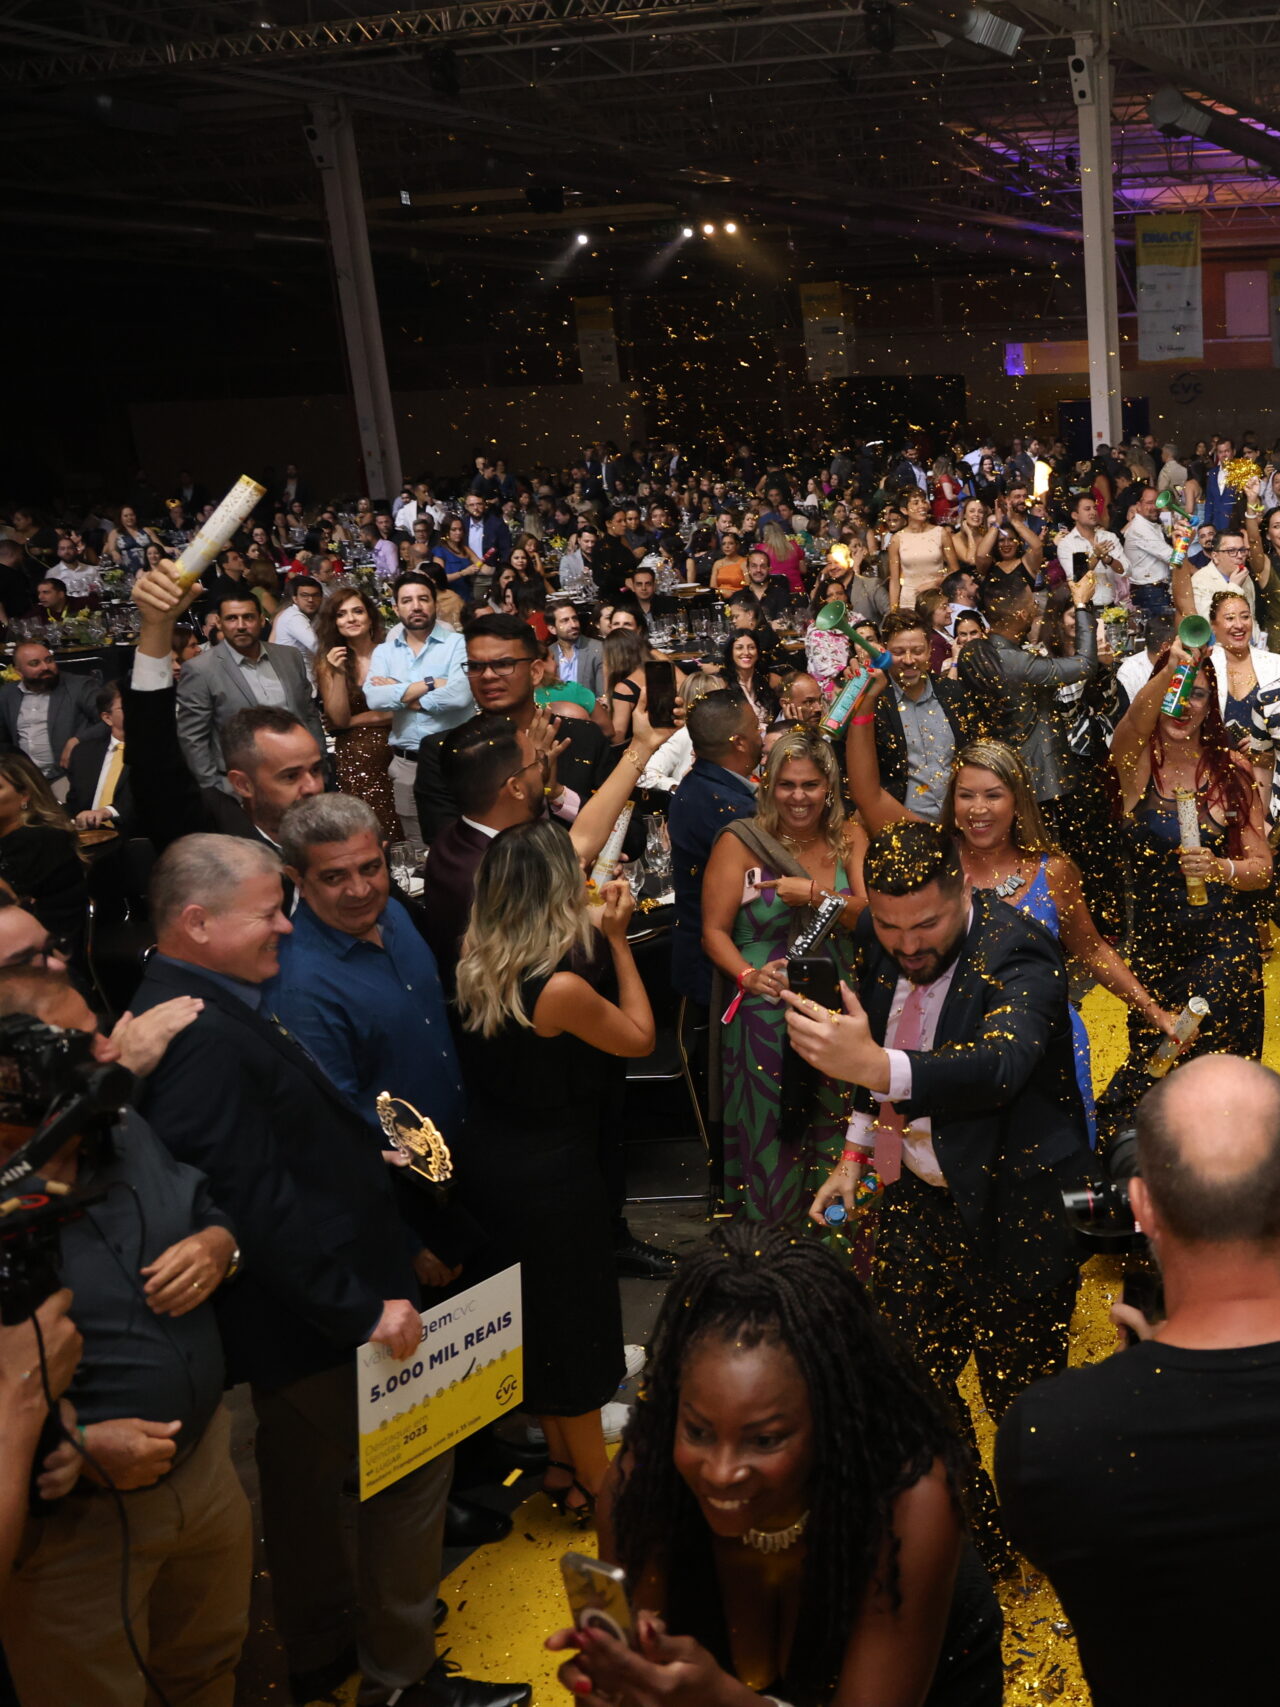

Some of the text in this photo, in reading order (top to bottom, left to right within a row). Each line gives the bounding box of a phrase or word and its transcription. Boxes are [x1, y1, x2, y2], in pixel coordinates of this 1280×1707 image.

[370, 1311, 512, 1403] 5.000 MIL REAIS
[403, 1424, 429, 1445] 2023
